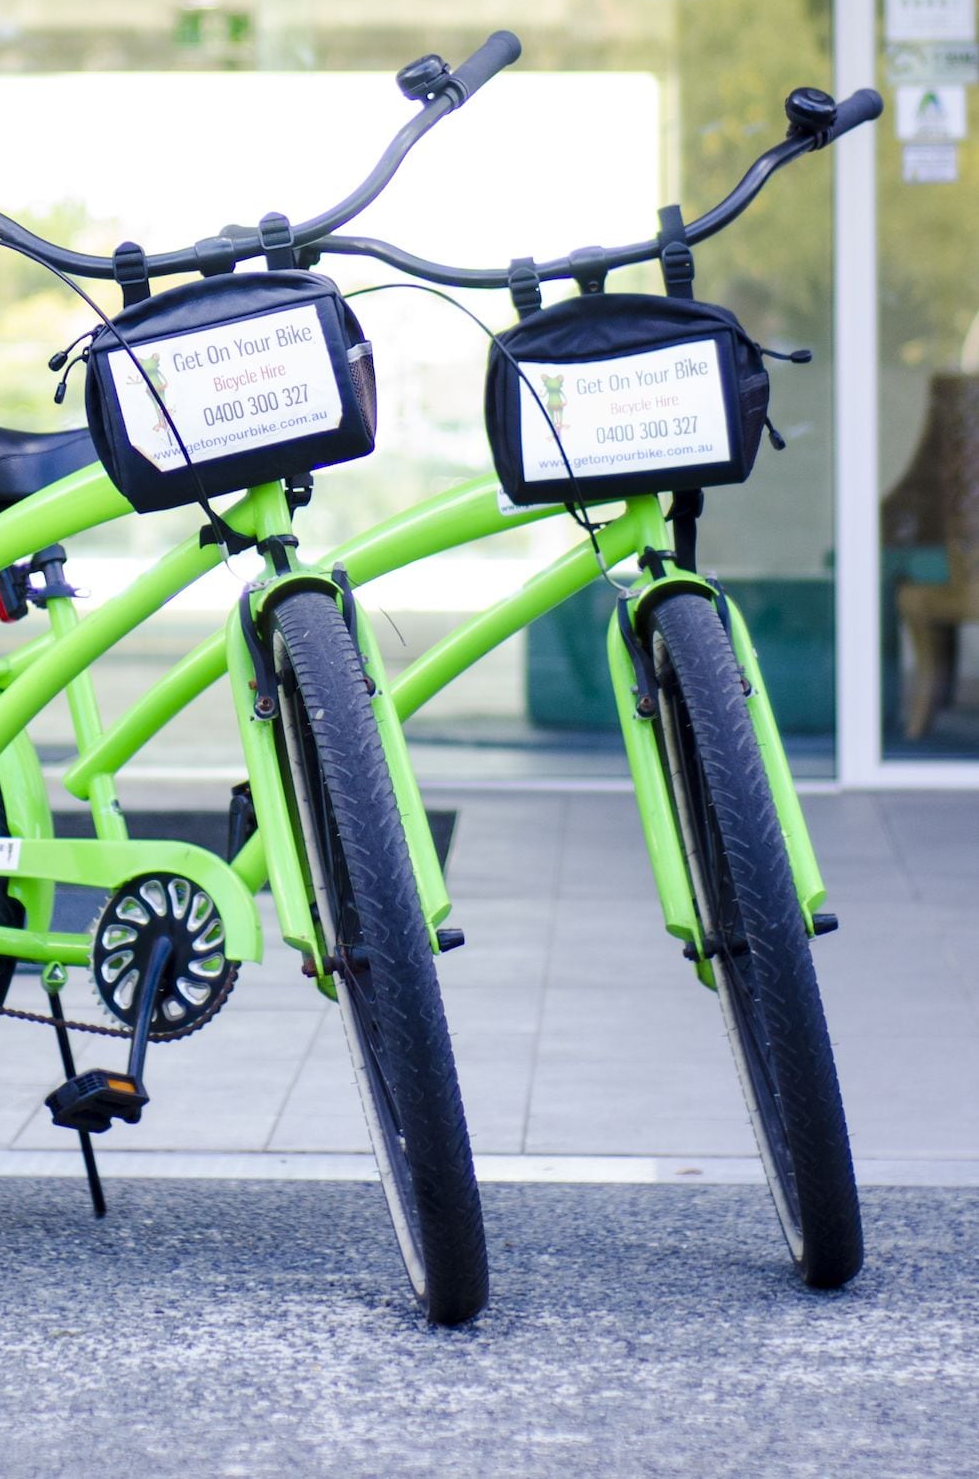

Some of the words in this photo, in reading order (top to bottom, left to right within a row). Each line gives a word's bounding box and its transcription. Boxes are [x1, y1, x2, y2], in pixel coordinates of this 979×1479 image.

[173, 350, 203, 372] Get
[207, 345, 231, 364] On
[234, 336, 271, 357] Your
[276, 325, 312, 347] Bike
[213, 368, 257, 393] Bicycle
[260, 364, 286, 381] Hire
[576, 376, 603, 395] Get
[609, 374, 630, 392] On
[634, 368, 669, 388] Your
[674, 358, 708, 380] Bike
[203, 400, 245, 427] 0400
[248, 391, 279, 416] 300
[282, 384, 309, 407] 327
[610, 398, 652, 416] Bicycle
[655, 395, 679, 408] Hire
[153, 410, 328, 460] wwwgetonyourbike.com.au
[596, 424, 634, 444] 0400
[640, 419, 668, 440] 300
[673, 416, 698, 436] 327
